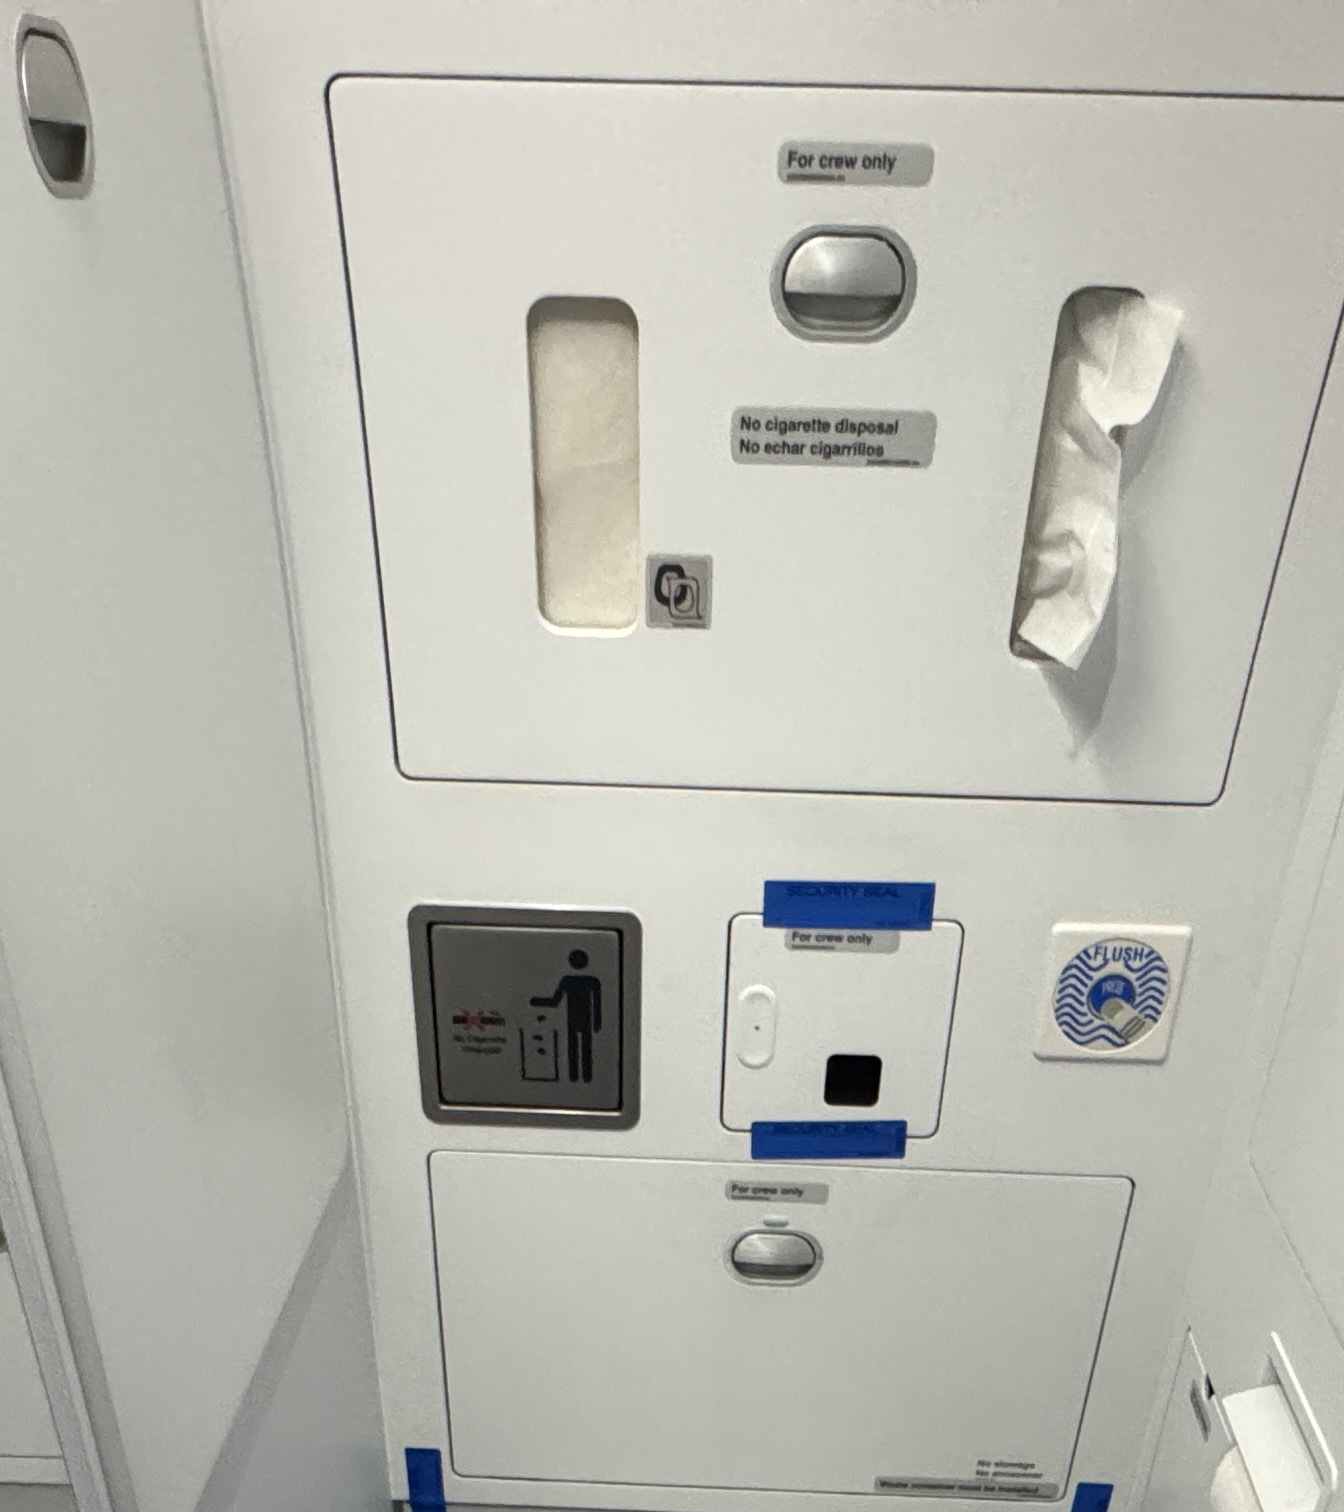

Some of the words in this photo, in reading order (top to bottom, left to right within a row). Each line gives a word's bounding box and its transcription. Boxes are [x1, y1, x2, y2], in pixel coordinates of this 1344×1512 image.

[786, 150, 815, 169] For
[819, 154, 857, 169] crew
[861, 151, 897, 174] only
[740, 416, 761, 431] No
[765, 417, 830, 435] cigarette
[835, 419, 899, 436] disposal
[739, 439, 760, 454] No
[764, 440, 806, 456] echar
[810, 441, 884, 460] cigarrillos
[791, 931, 812, 944] For
[814, 934, 843, 944] crew
[846, 931, 874, 946] only
[1092, 944, 1145, 962] FLUSH
